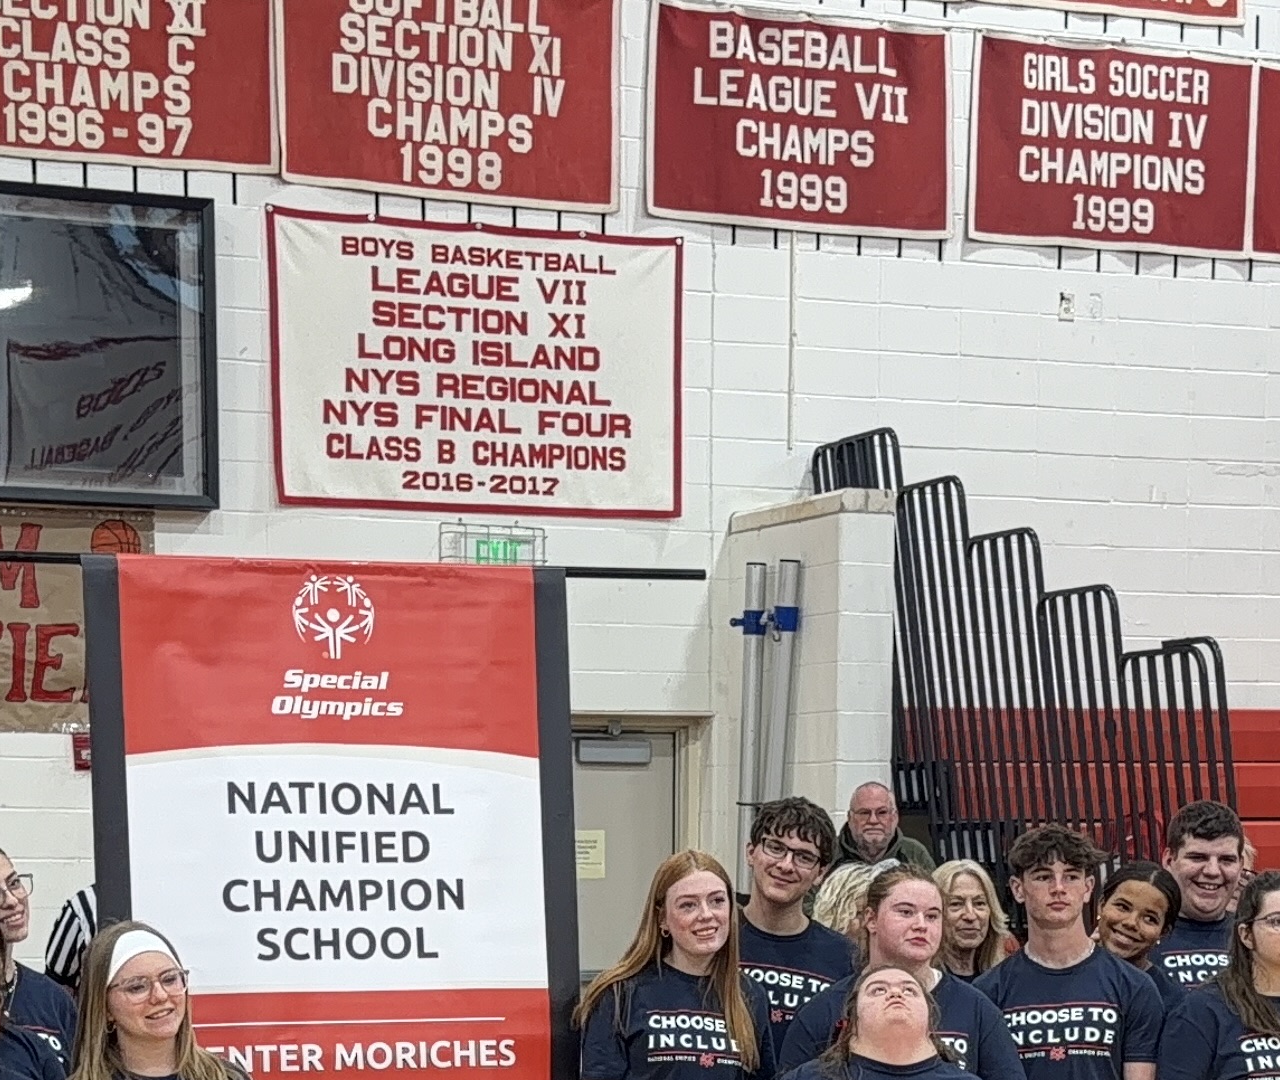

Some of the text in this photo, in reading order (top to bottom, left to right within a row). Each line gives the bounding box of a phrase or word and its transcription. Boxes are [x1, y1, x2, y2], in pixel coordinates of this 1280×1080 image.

[168, 36, 195, 75] C
[341, 13, 560, 76] SECTION XI
[710, 21, 896, 77] BASEBALL
[3, 60, 190, 123] CHAMPS
[332, 52, 565, 117] DIVISION IV
[694, 67, 908, 124] LEAGUE VII
[1024, 53, 1209, 105] GIRLS SOCCER
[3, 102, 192, 155] 1996-97
[368, 98, 532, 153] CHAMPS
[736, 119, 874, 167] CHAMPS
[1021, 99, 1207, 149] DIVISION IV
[401, 142, 501, 190] 1998
[1019, 146, 1205, 194] CHAMPIONS
[761, 169, 847, 213] 1999
[1073, 194, 1154, 233] 1999
[342, 236, 616, 275] BOYS BASKETBALL
[372, 266, 586, 305] LEAGUE VII
[373, 300, 585, 339] SECTION XI
[358, 333, 600, 371] LONG ISLAND
[346, 368, 611, 406] NYS REGIONAL
[323, 399, 631, 438] NYS FINAL FOUR
[326, 433, 625, 471] CLASS B CHAMPIONS
[402, 471, 559, 496] 2016-2017
[284, 670, 389, 692] Special
[272, 696, 403, 720] Olympics
[228, 782, 454, 815] NATIONAL
[255, 831, 429, 863] UNIFIED
[223, 879, 464, 912] CHAMPION
[257, 927, 438, 961] SCHOOL
[649, 1015, 727, 1033] CHOOSE
[1088, 1008, 1117, 1023] TO
[335, 1040, 515, 1070] MORICHES
[1011, 1027, 1115, 1045] NCLUDE
